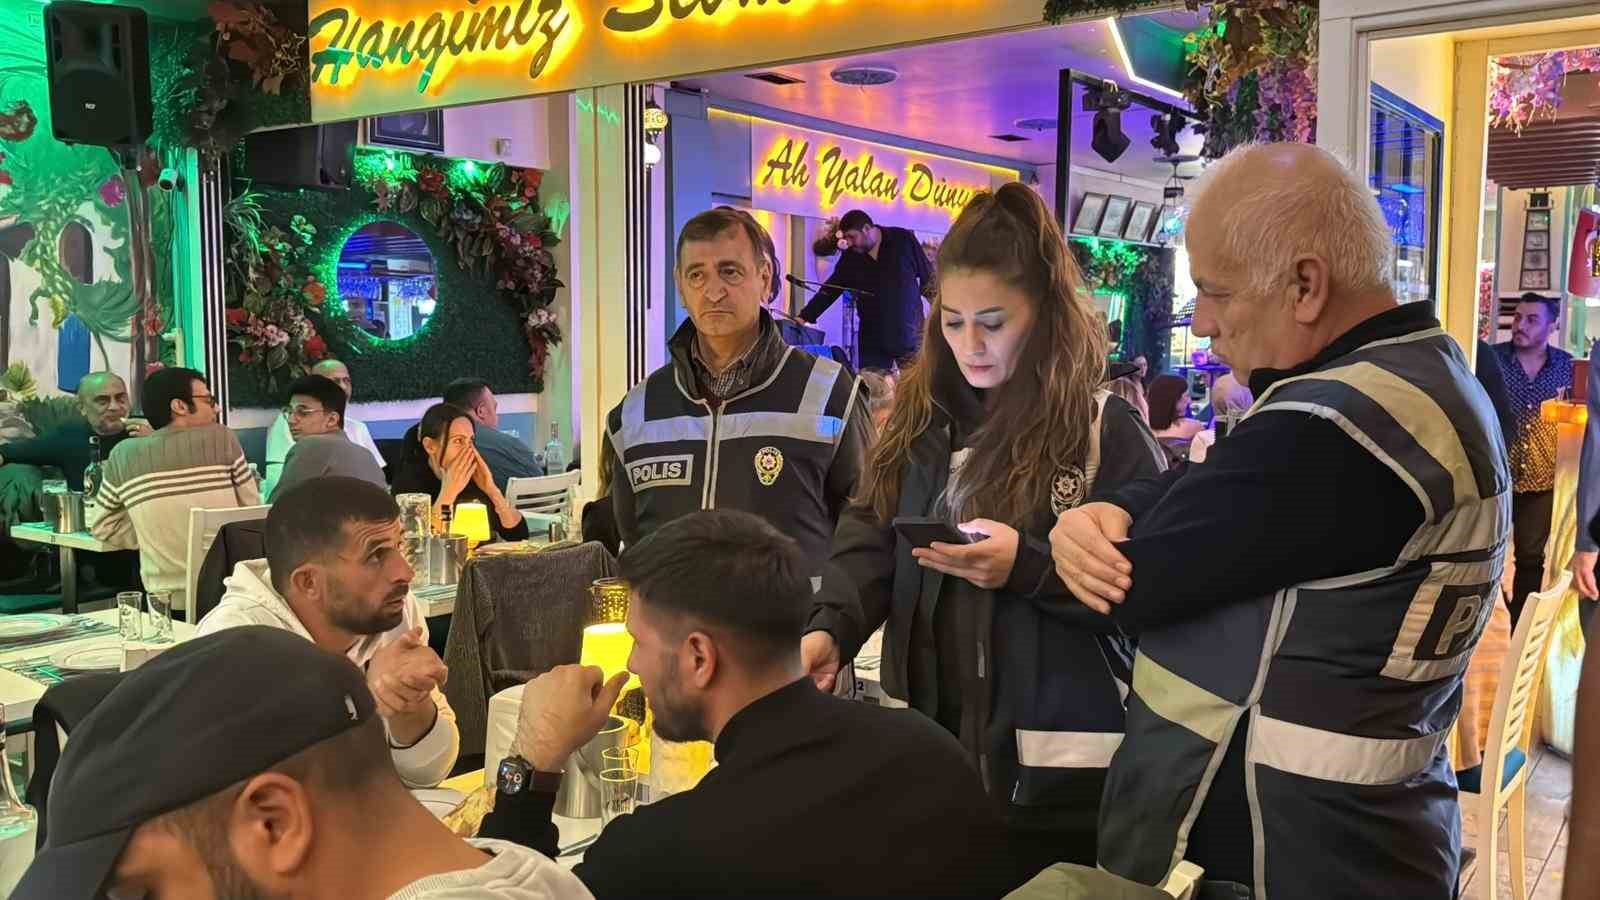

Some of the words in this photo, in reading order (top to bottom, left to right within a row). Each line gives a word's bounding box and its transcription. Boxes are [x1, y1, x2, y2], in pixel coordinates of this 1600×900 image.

[307, 0, 569, 93] Hangimiz
[762, 139, 810, 188] Ah
[822, 146, 900, 205] Yalan
[909, 163, 971, 208] Düny
[1434, 594, 1482, 655] P
